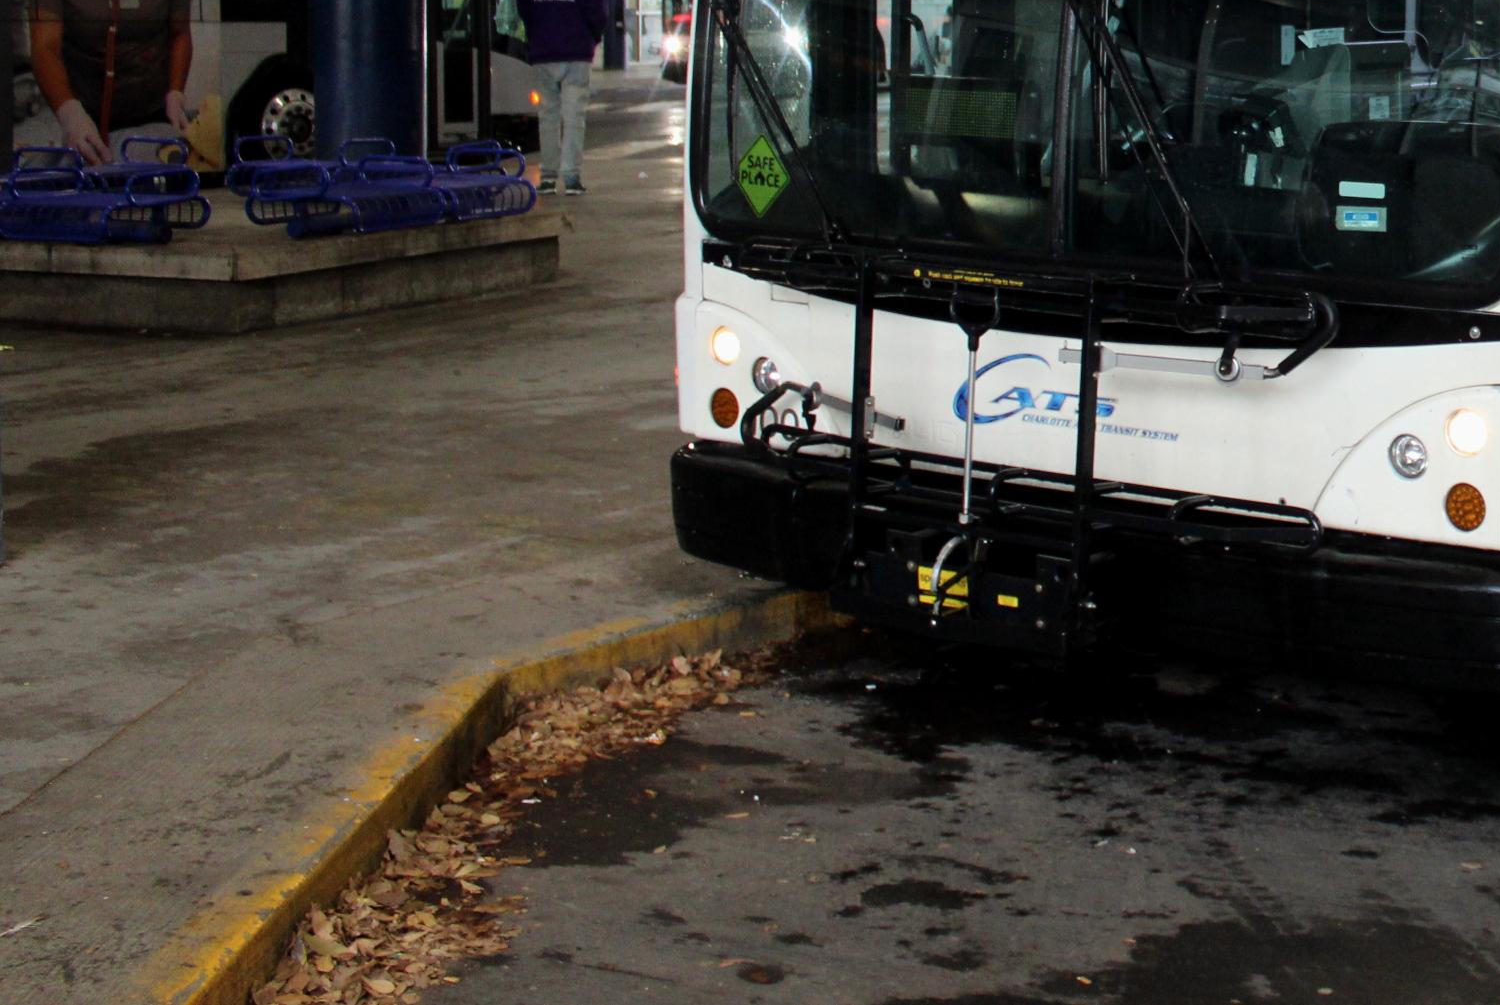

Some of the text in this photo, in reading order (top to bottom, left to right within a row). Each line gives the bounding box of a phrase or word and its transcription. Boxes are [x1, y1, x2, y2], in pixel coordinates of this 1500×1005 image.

[747, 155, 775, 172] SAFE
[741, 170, 781, 187] PLACE
[953, 353, 1116, 424] CATS
[1021, 413, 1072, 428] CHARLOTTE
[1100, 425, 1140, 438] TRANSIT
[1140, 430, 1180, 443] SYSTEM
